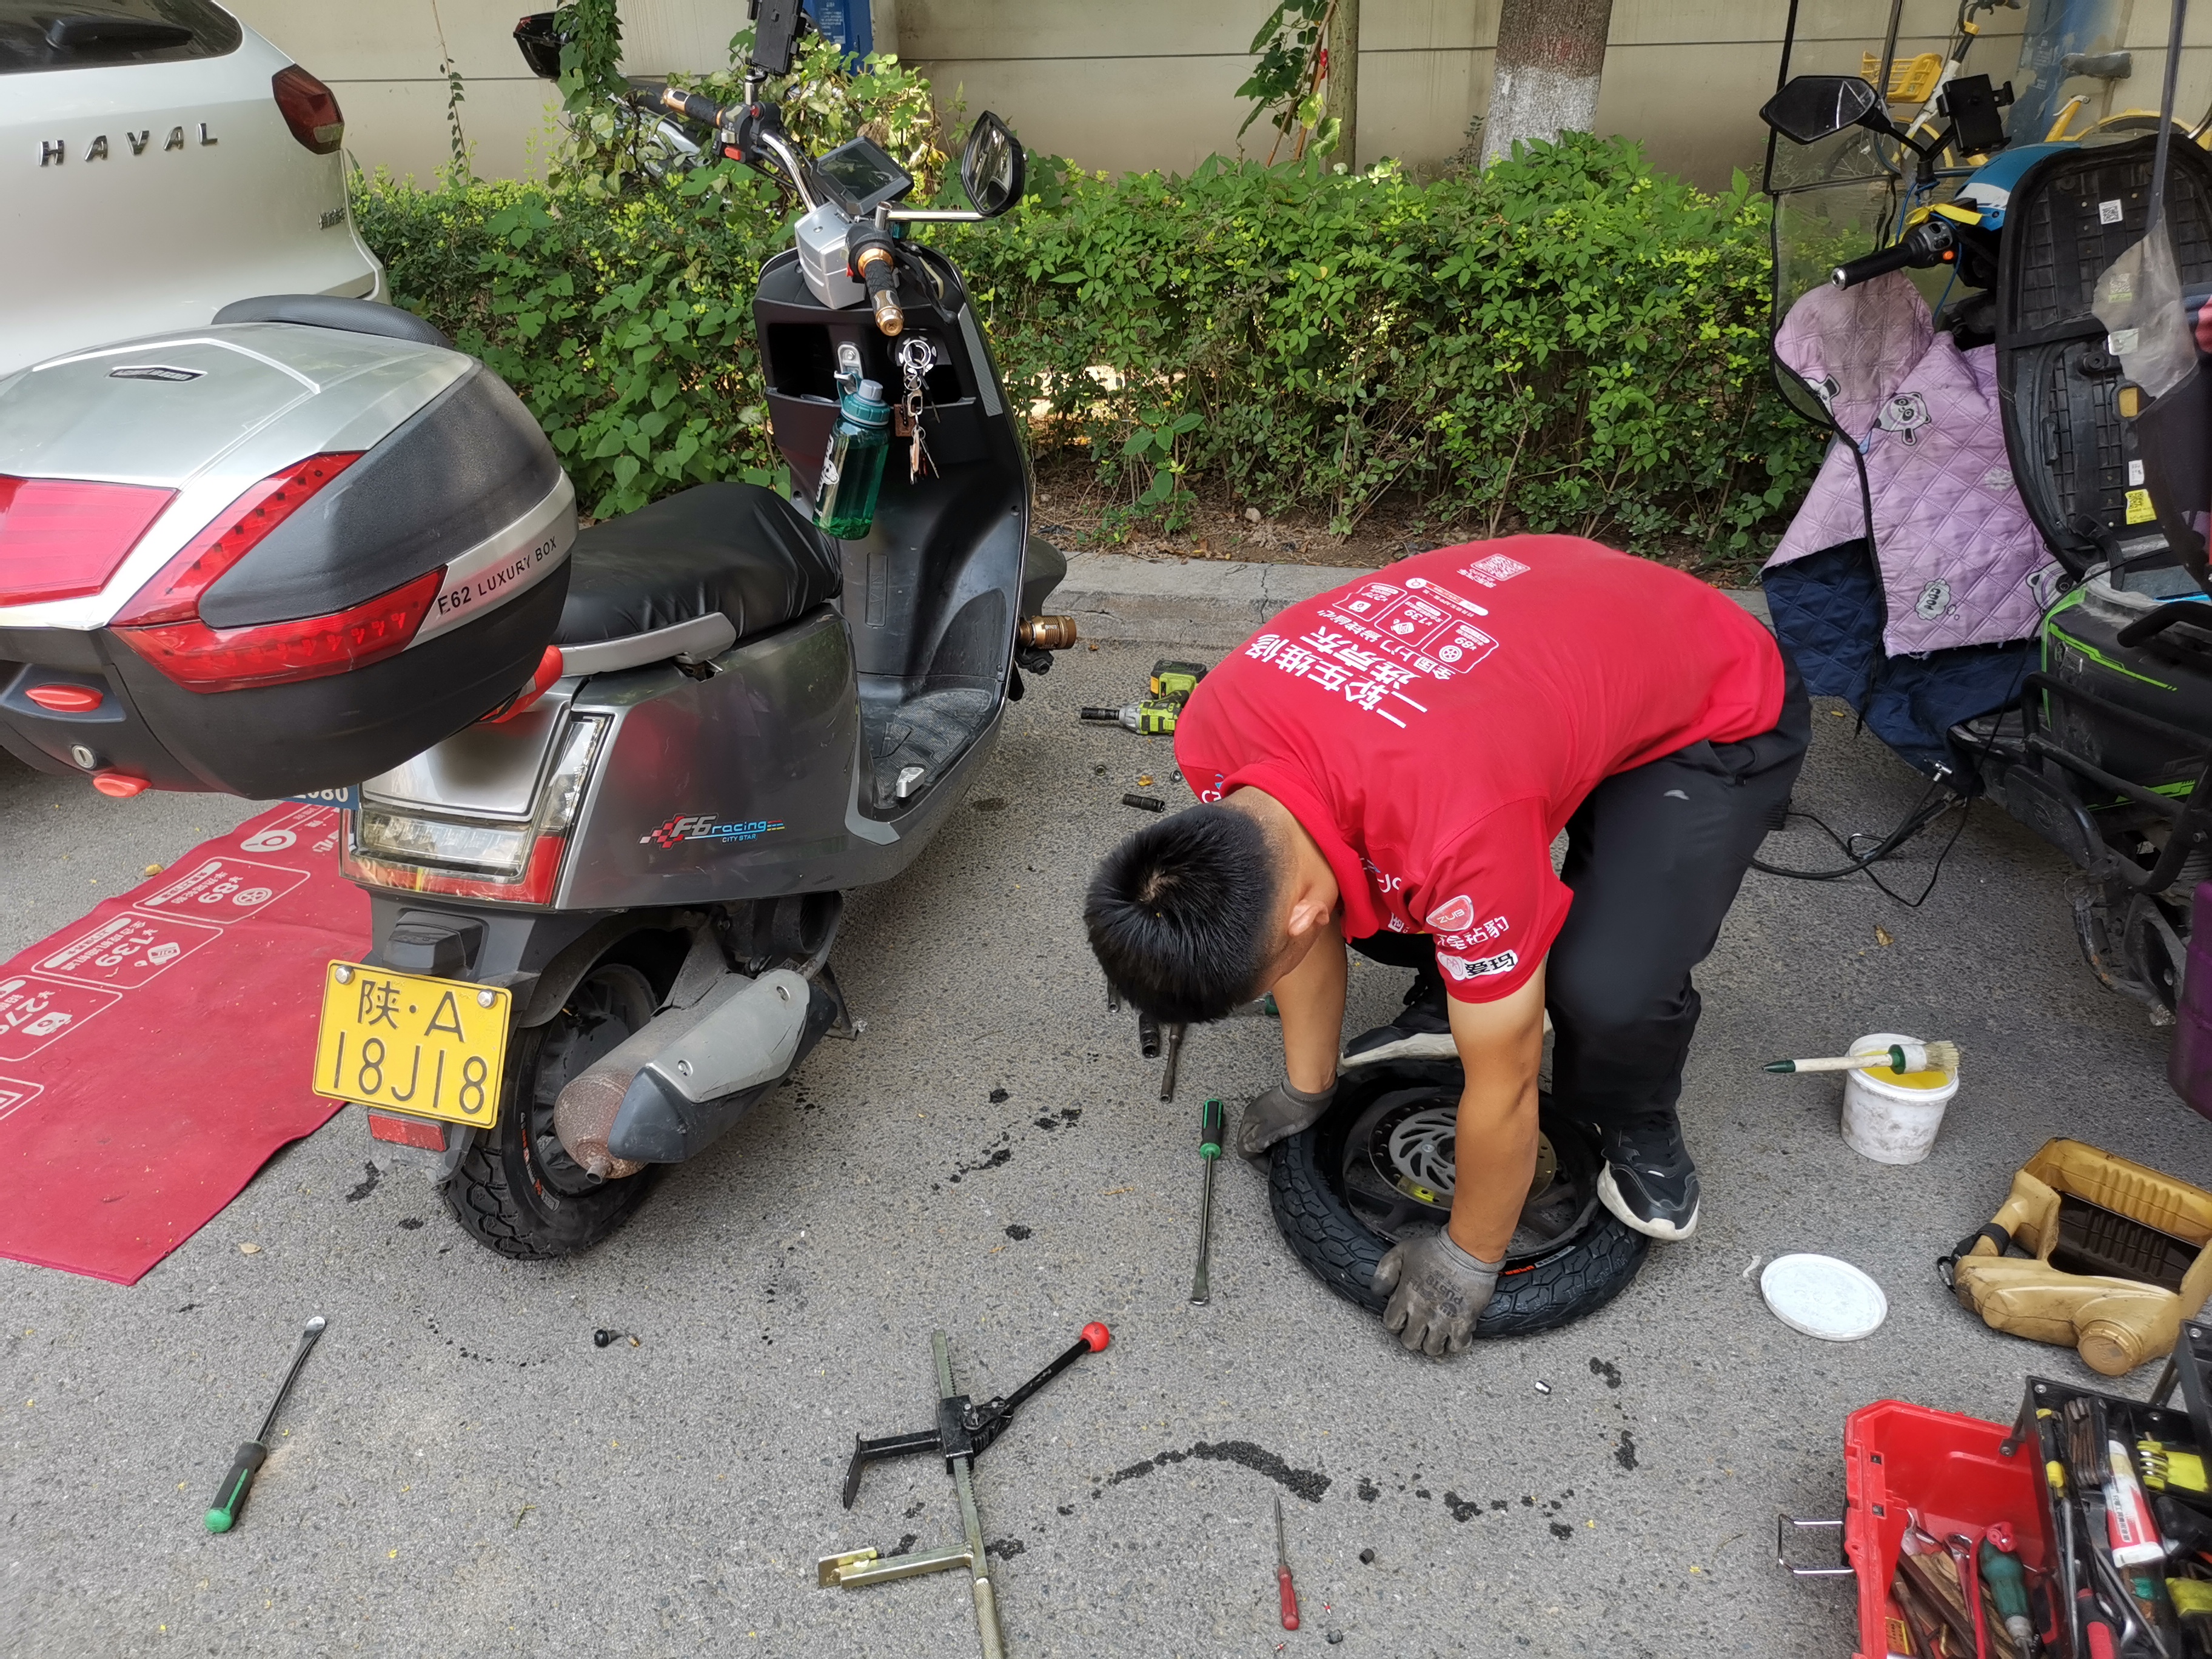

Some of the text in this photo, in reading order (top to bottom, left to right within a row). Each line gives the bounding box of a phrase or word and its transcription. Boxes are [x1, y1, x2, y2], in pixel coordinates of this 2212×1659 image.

[39, 122, 218, 167] HAVAL
[478, 554, 530, 596] LUXURY
[535, 535, 557, 561] BOX
[1299, 626, 1423, 691] 选京东
[1316, 609, 1456, 680] 全国上门 省钱省心
[1244, 634, 1428, 729] 二轮车维修
[711, 821, 767, 834] racing
[198, 876, 244, 903] ¥89
[95, 928, 158, 967] ¥139
[1464, 953, 1515, 976] 爱玛
[358, 979, 466, 1043] 陕·A
[333, 1031, 488, 1114] 18J18
